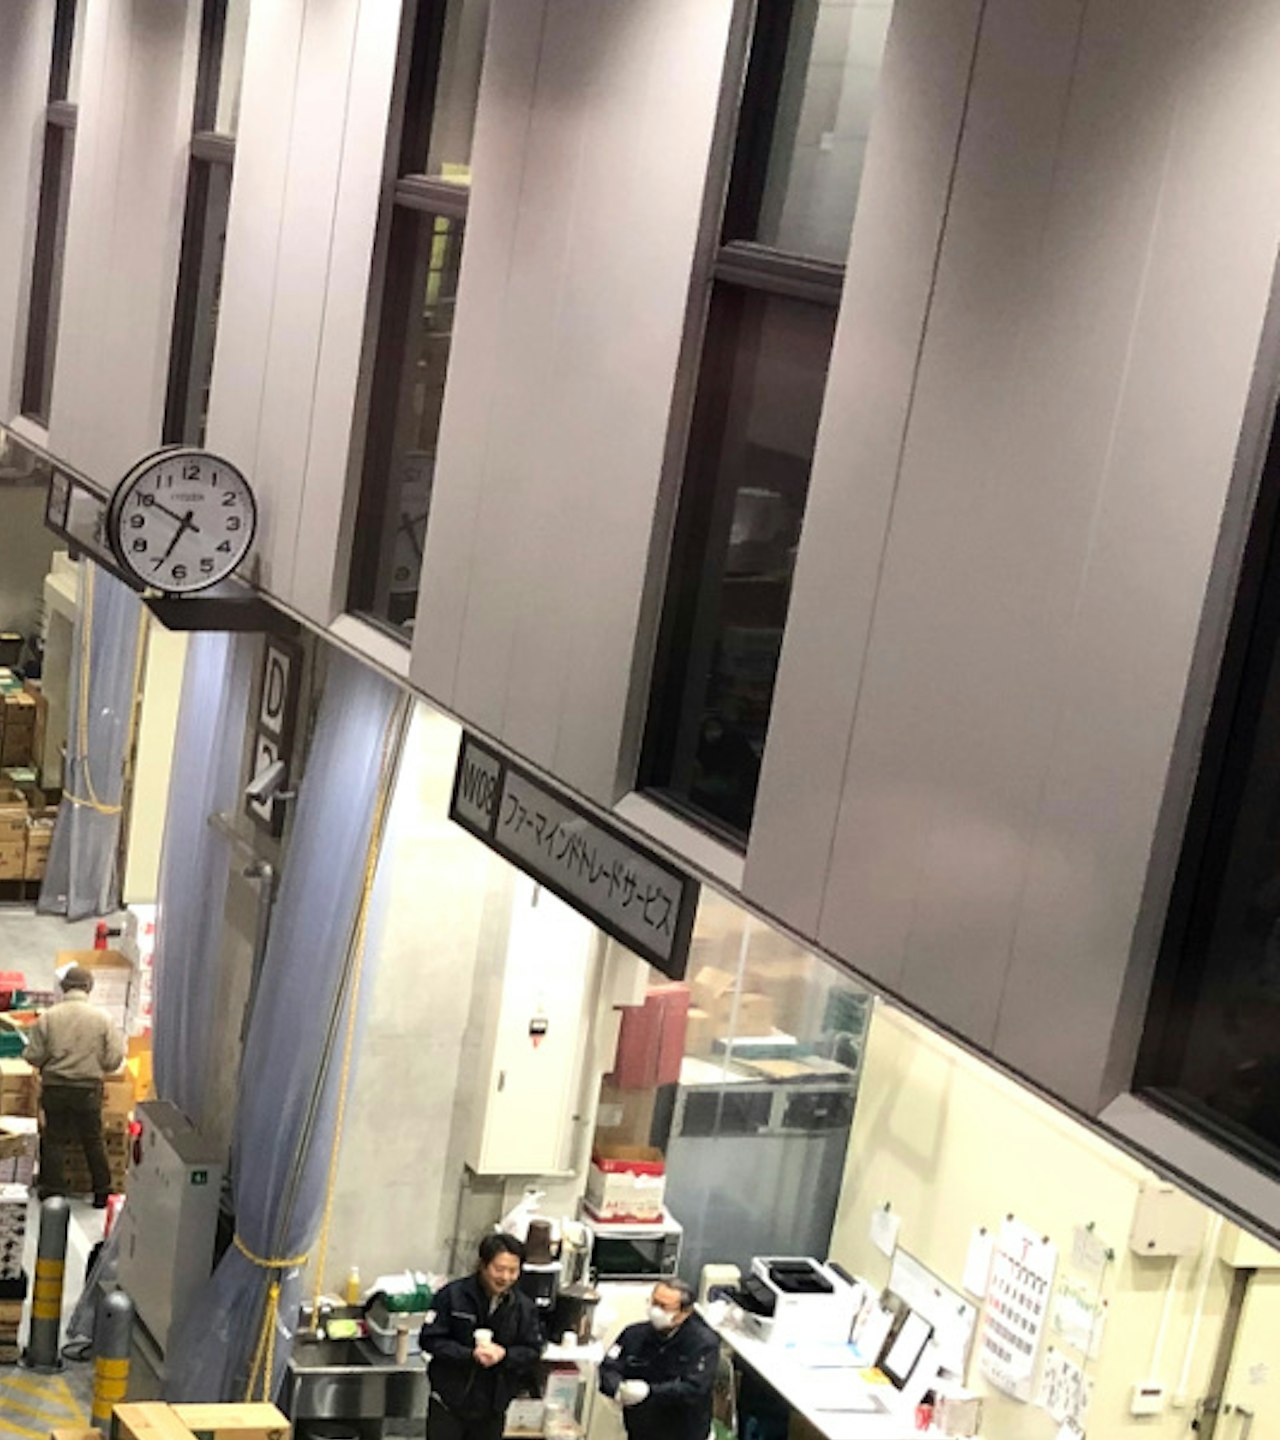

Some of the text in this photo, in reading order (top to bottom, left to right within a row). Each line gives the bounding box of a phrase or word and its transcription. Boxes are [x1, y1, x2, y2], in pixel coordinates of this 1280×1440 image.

[182, 465, 201, 481] 12
[212, 472, 218, 487] 1
[155, 475, 173, 489] 11
[221, 491, 237, 507] 2
[130, 513, 145, 529] 9
[225, 516, 241, 531] 3
[132, 538, 148, 552] 8
[215, 540, 232, 553] 4
[171, 564, 187, 579] 6
[199, 558, 214, 573] 5
[504, 793, 672, 937] ファーマインドトレードサービス
